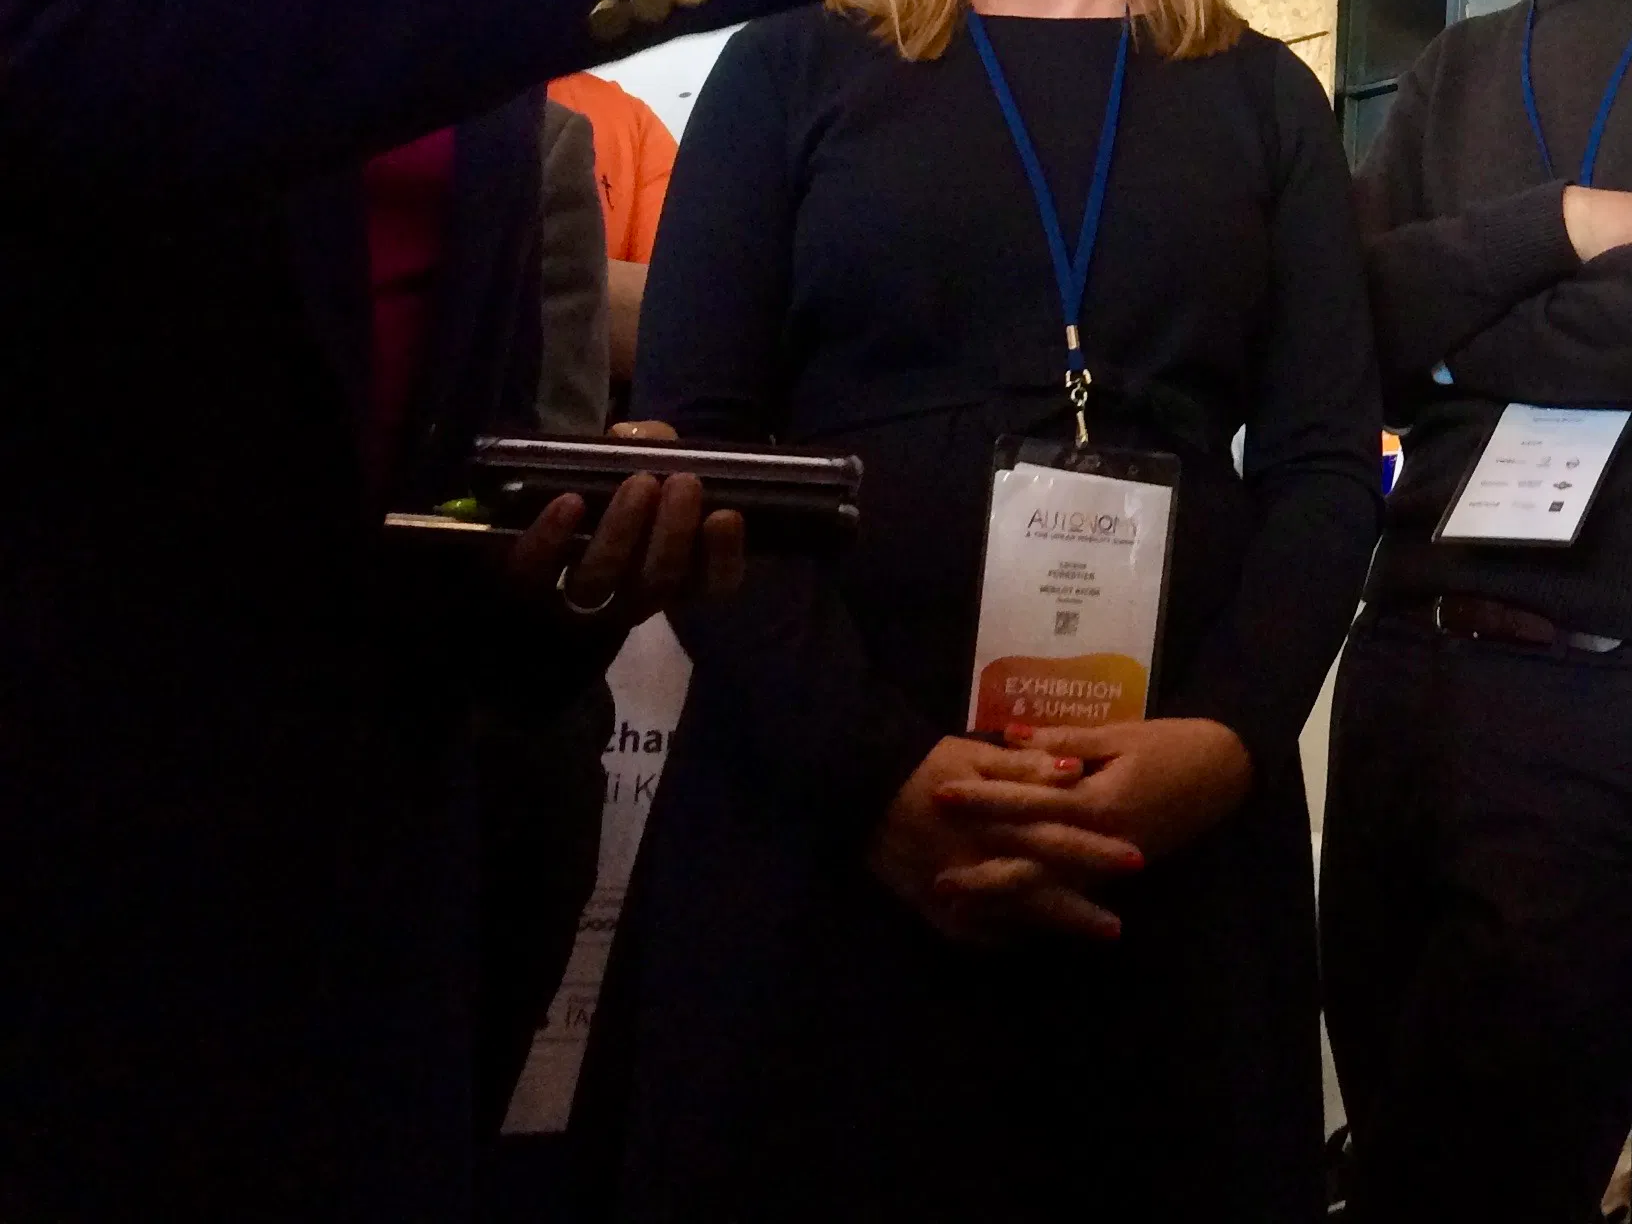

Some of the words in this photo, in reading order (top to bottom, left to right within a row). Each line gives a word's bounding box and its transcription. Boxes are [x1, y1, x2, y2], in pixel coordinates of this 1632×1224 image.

[1004, 677, 1122, 698] EXHIBITION
[1012, 698, 1025, 716] &
[1032, 700, 1111, 719] SUMMIT
